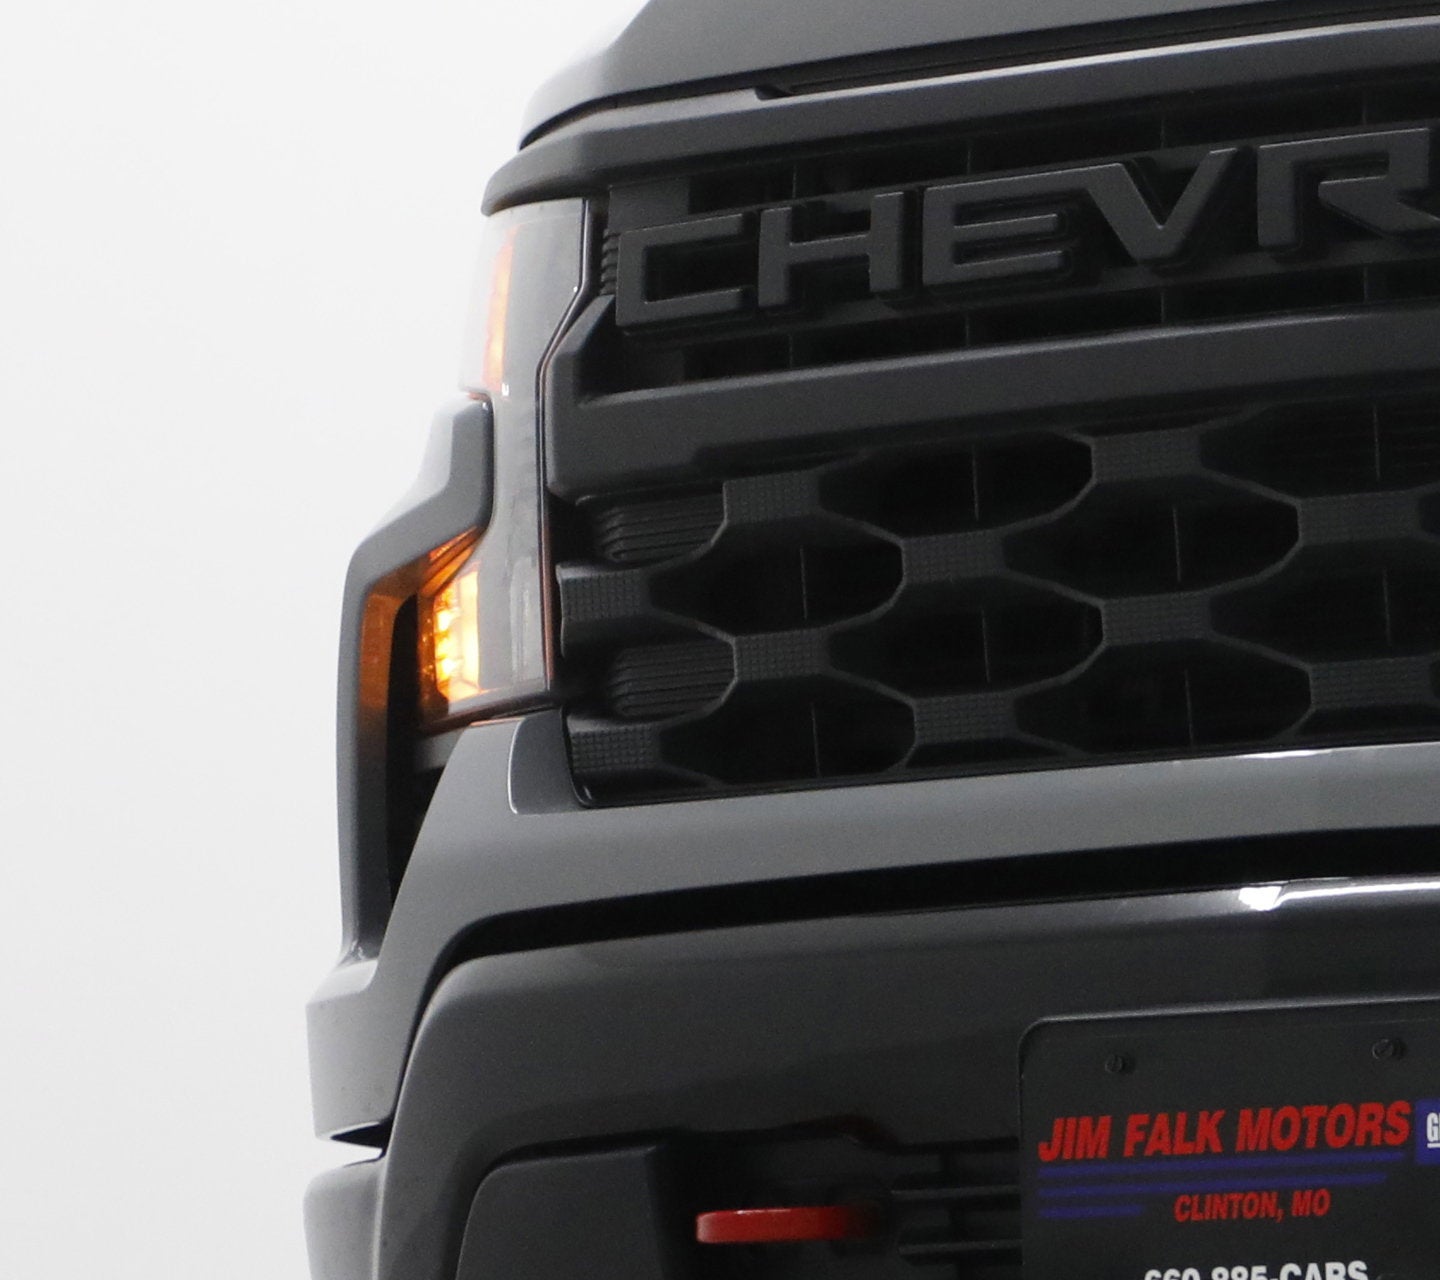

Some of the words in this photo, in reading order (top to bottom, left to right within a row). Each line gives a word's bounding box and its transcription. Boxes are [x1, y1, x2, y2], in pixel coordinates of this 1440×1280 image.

[1038, 1115, 1113, 1162] JIM
[1122, 1108, 1227, 1158] FALK
[1235, 1099, 1413, 1154] MOTORS
[1172, 1190, 1285, 1223] CLINTON,
[1291, 1188, 1332, 1218] MO
